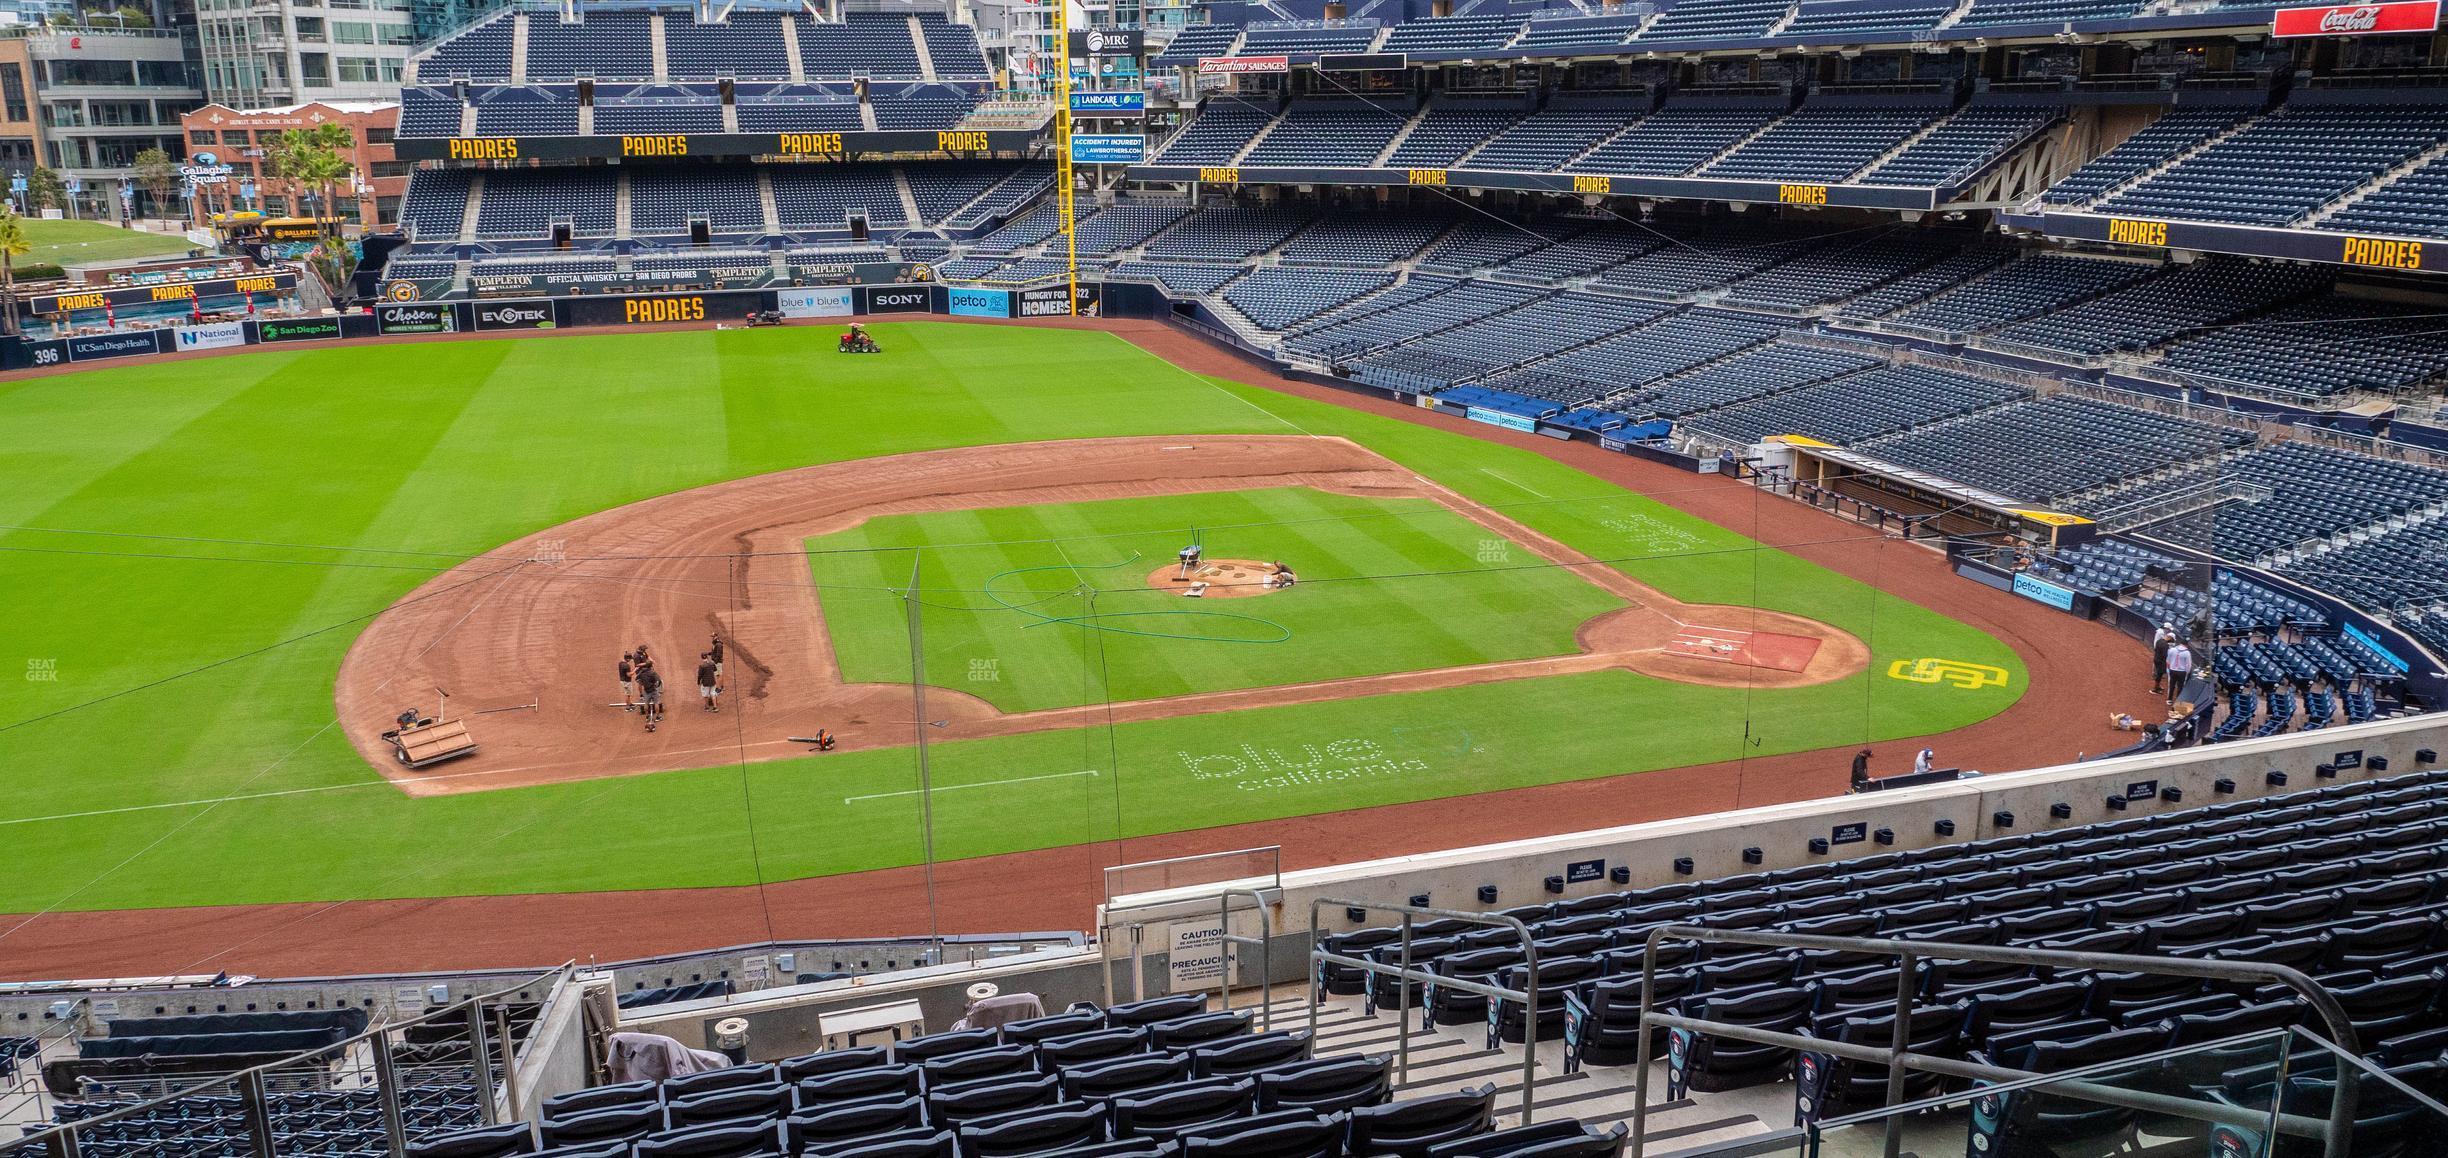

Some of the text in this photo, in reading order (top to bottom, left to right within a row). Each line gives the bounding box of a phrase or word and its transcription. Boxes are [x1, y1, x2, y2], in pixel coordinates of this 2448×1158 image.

[2320, 7, 2382, 31] Coca-Cola
[1104, 35, 1129, 45] MRC
[1201, 60, 1286, 72] Tarantino SAUSAGES
[1082, 95, 1142, 106] LANDCARE LOGIC
[449, 138, 518, 159] PADRES
[622, 136, 687, 156] PADRES
[780, 133, 842, 153] PADRES
[938, 131, 988, 151] PADRES
[180, 165, 233, 176] Gallagher
[1200, 168, 1238, 182] PADRES
[1409, 169, 1447, 185] PADRES
[189, 173, 227, 185] Square
[1573, 175, 1610, 194] PADRES
[1779, 185, 1827, 205] PADRES
[2108, 219, 2167, 246] PADRES
[2343, 237, 2421, 270] PADRES
[547, 275, 582, 283] OFFICIAL
[583, 273, 618, 282] WHISKEY
[635, 272, 650, 280] SAN
[651, 271, 670, 280] DIEGO
[672, 270, 697, 279] PADRES
[710, 267, 767, 278] TEMPLETON
[802, 264, 855, 275] TEMPLETON
[236, 278, 276, 293] PADRES
[473, 276, 532, 287] TEMPLETON
[152, 285, 195, 301] PADRES
[817, 295, 839, 306] blue
[876, 294, 924, 305] SONY
[1025, 290, 1067, 300] HUNGRY FOR
[1076, 288, 1089, 299] 322
[57, 293, 105, 311] PADRES
[781, 297, 804, 307] blue
[953, 294, 987, 308] petco
[1022, 299, 1071, 316] HOMERS
[385, 307, 437, 322] Chosen
[482, 308, 546, 324] EVOTEK
[626, 297, 705, 322] PADRES
[200, 328, 239, 340] National
[280, 324, 337, 335] San Diego Zoo
[91, 342, 105, 351] San
[105, 341, 126, 352] Diego
[126, 339, 150, 348] Health
[35, 348, 58, 364] 396
[2016, 580, 2042, 595] petco
[1177, 738, 1384, 780] blue
[1237, 759, 1428, 791] california
[1172, 954, 1235, 969] PRECAUCIN
